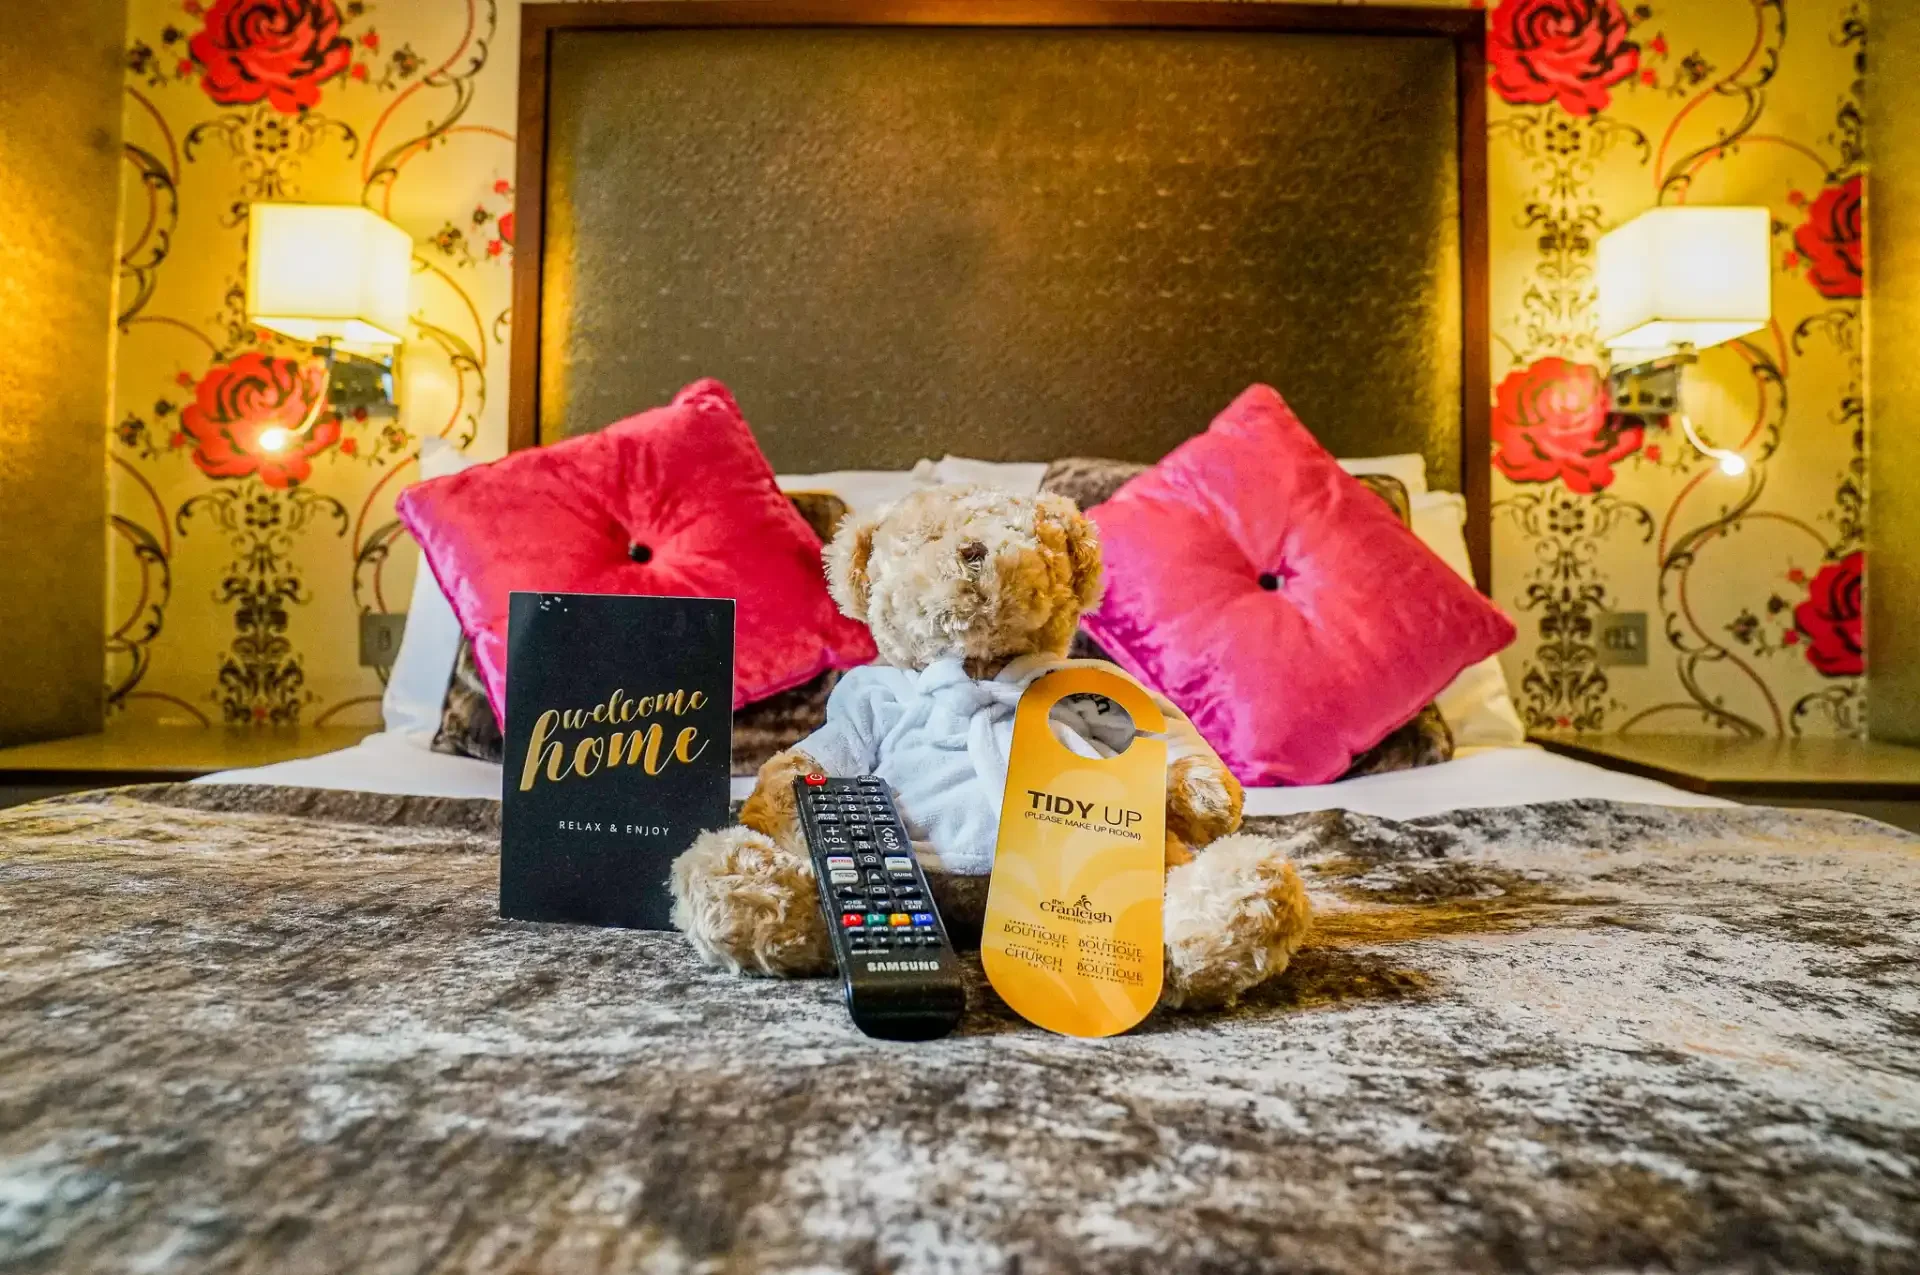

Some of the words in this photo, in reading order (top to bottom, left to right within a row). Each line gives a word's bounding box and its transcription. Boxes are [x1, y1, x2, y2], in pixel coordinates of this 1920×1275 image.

[562, 688, 709, 730] welcome
[519, 709, 710, 792] home
[1027, 790, 1095, 820] TIDY
[1104, 805, 1142, 827] UP
[559, 820, 601, 832] RELAX
[609, 823, 618, 833] &
[626, 824, 670, 836] ENJOY
[1024, 810, 1062, 825] (PLEASE
[1064, 818, 1092, 831] MAKE
[1093, 824, 1107, 833] UP
[1108, 828, 1141, 841] ROOM)
[1051, 898, 1065, 906] the
[1040, 901, 1112, 924] Cranleigh
[1003, 923, 1069, 944] BOUTIQUE
[1004, 947, 1063, 967] CHURCH
[1078, 938, 1144, 958] BOUTIQUE
[866, 961, 940, 973] SAMSUNG
[1076, 961, 1144, 981] BOUTIQUE
